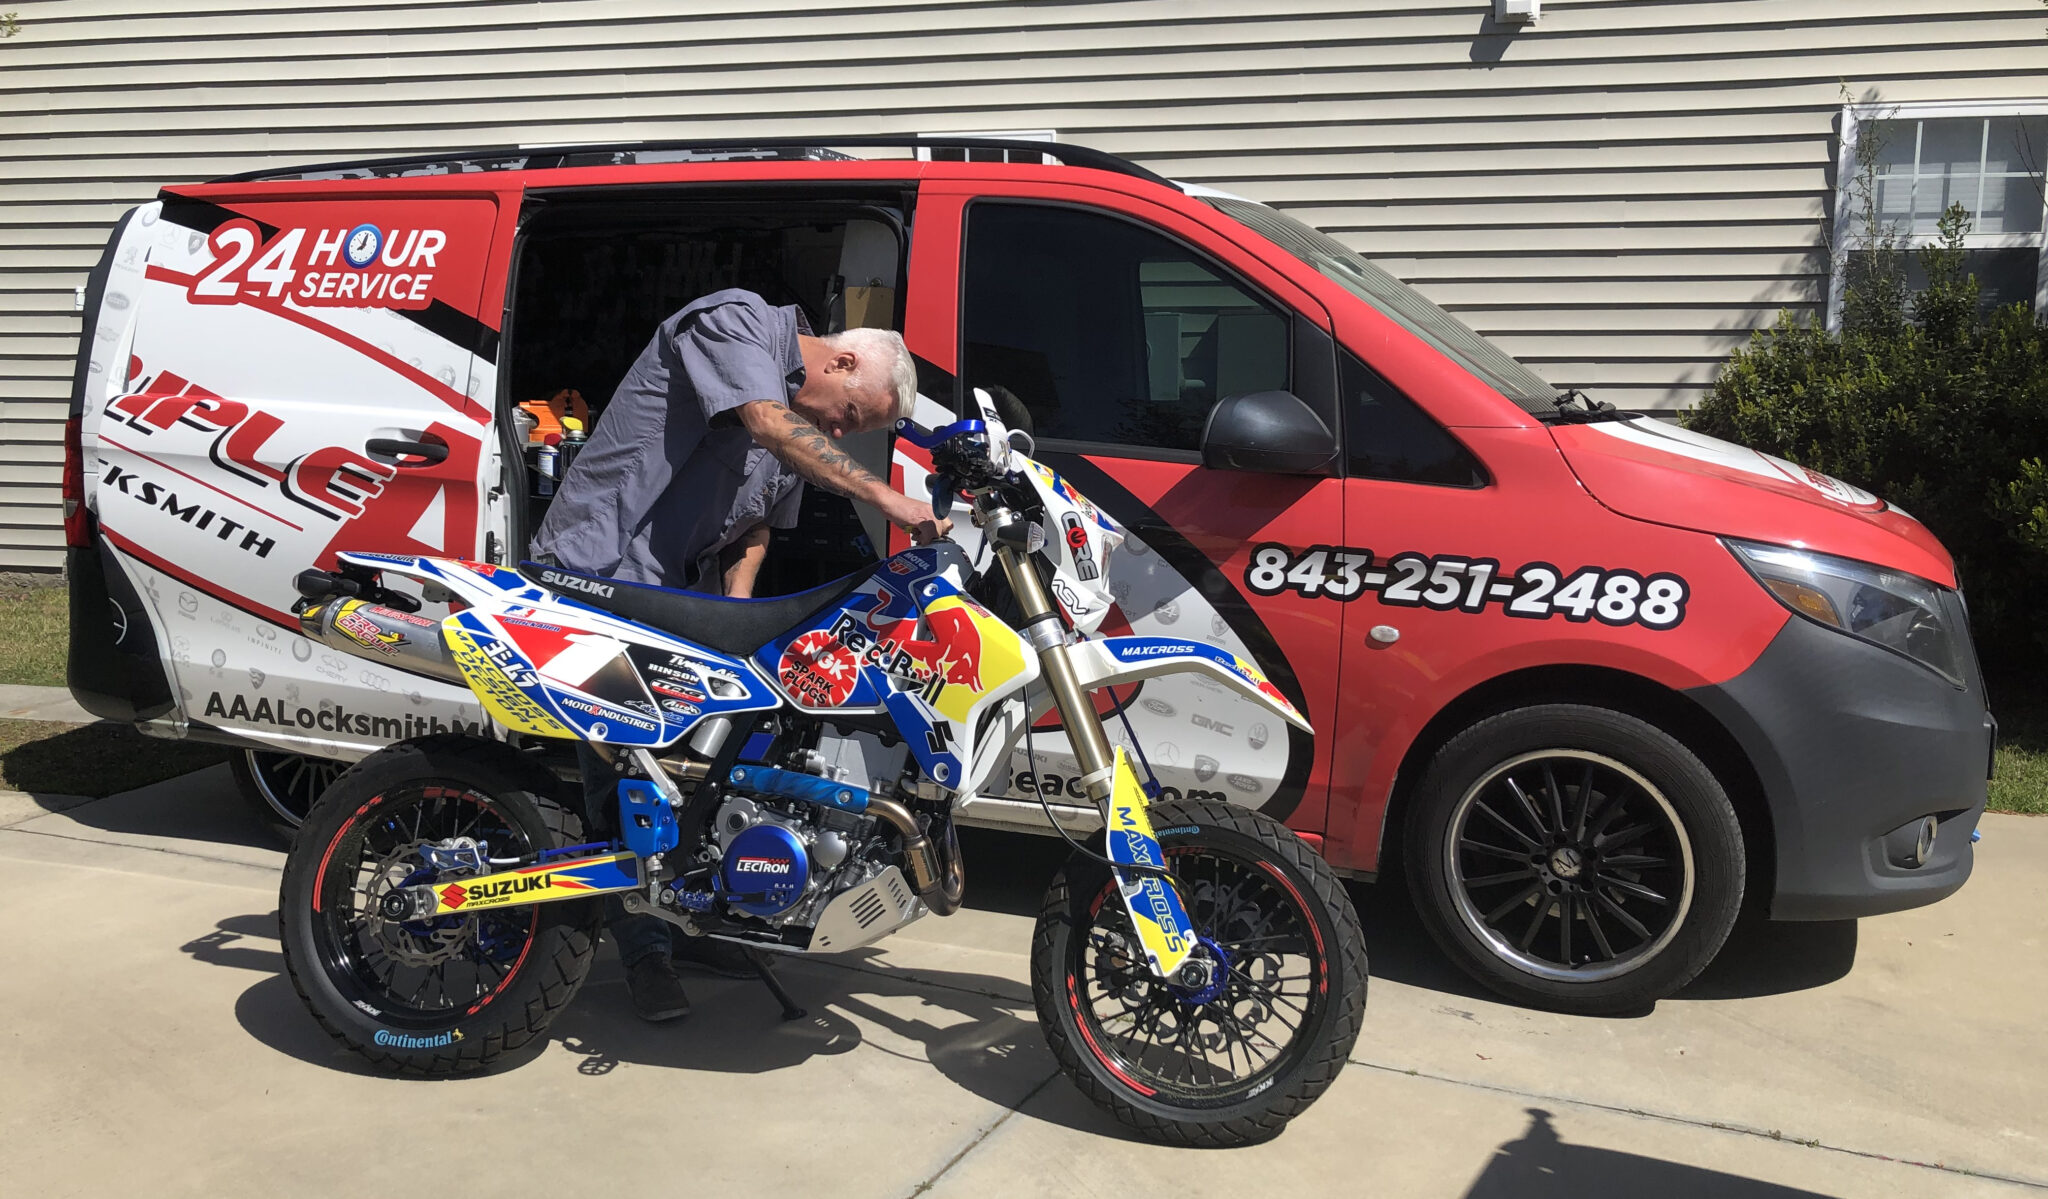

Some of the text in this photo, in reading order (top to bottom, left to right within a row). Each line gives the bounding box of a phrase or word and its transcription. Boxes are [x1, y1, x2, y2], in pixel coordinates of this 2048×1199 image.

[195, 223, 447, 298] 24 HOUR
[298, 272, 433, 301] SERVICE
[98, 458, 276, 559] KSMITH
[904, 552, 931, 571] MOTUL
[540, 570, 615, 599] SUZUKI
[1247, 546, 1686, 626] 843-251-2488
[338, 617, 400, 656] CIRCUIT
[346, 612, 382, 635] PRO
[802, 643, 850, 680] NGK
[1122, 645, 1195, 657] MAXCROSS
[453, 630, 564, 730] MAXCROSS
[460, 651, 538, 719] DESIGN
[648, 663, 700, 683] HINSON
[784, 669, 828, 705] PLUGS
[791, 660, 835, 697] SPARK
[1191, 713, 1234, 738] GMC
[736, 859, 790, 875] LECTRON
[468, 873, 552, 899] SUZUKI
[466, 896, 511, 908] MAXCROSS
[374, 1028, 453, 1050] Continental
